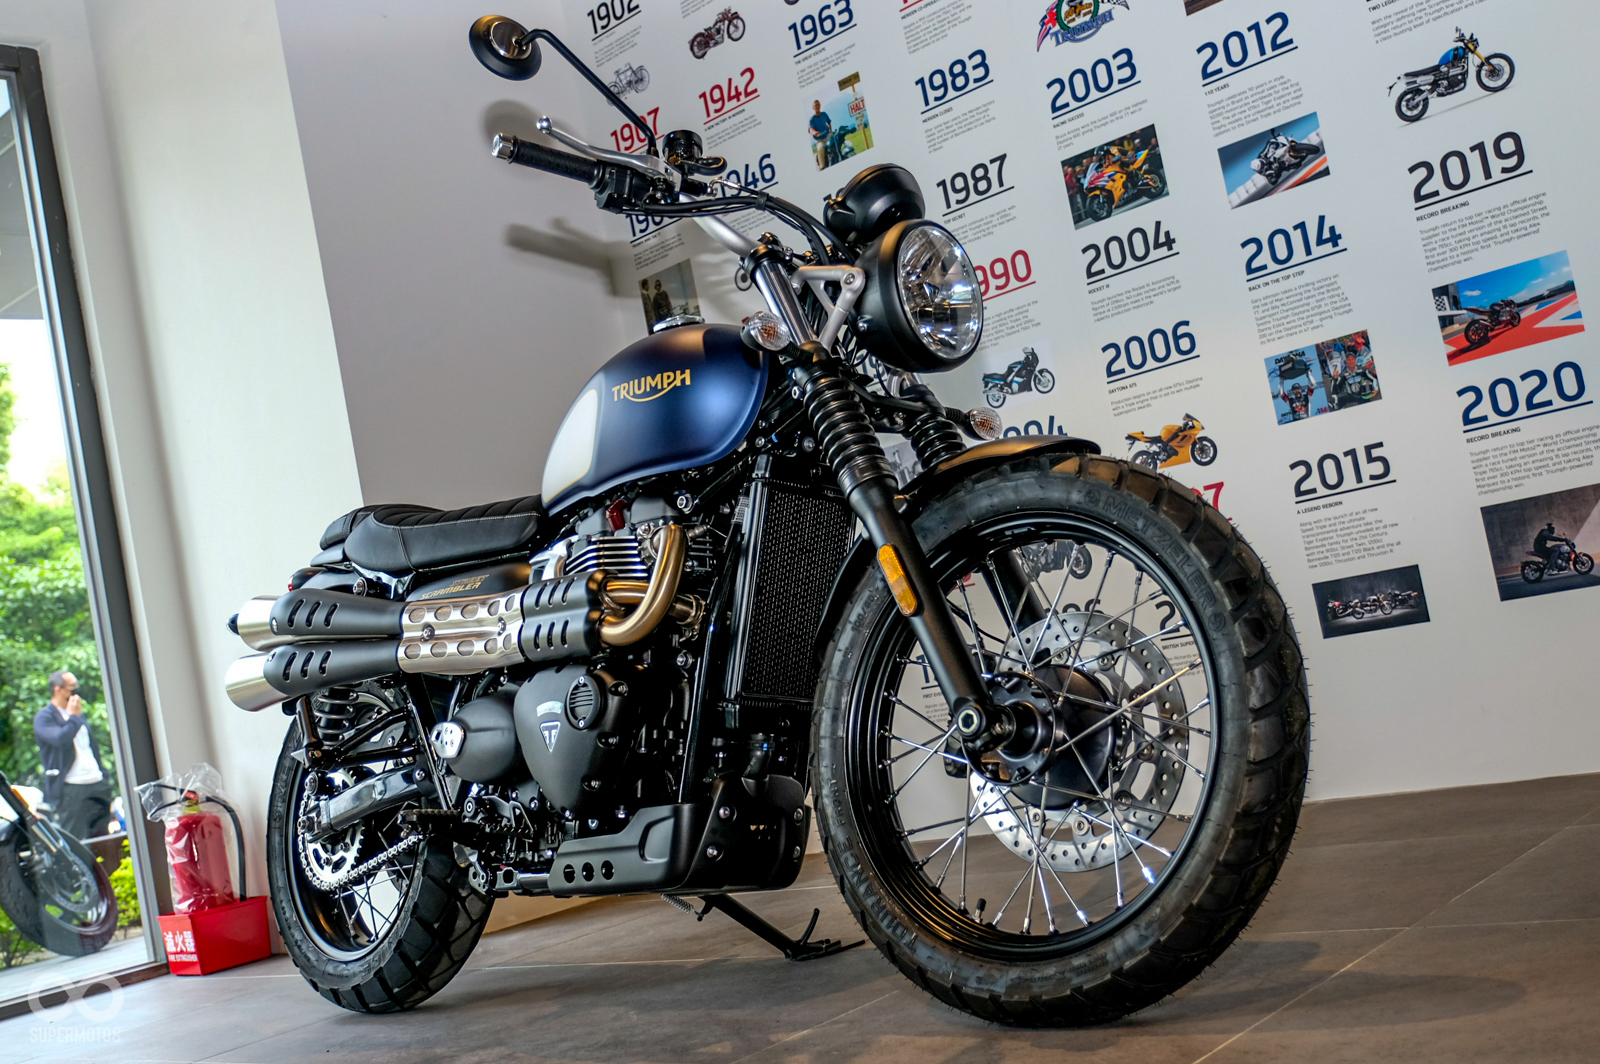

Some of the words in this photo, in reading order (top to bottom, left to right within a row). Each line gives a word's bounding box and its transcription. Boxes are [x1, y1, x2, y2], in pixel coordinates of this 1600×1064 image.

[587, 0, 640, 35] 1902
[788, 0, 853, 51] 1963
[1368, 5, 1381, 13] TWO
[1371, 17, 1383, 26] With
[1384, 13, 1393, 21] the
[1393, 7, 1408, 18] reveal
[1415, 1, 1424, 9] the
[1372, 12, 1416, 32] category-defining
[1374, 29, 1390, 38] names
[1391, 22, 1407, 31] return
[1414, 14, 1424, 22] the
[1424, 7, 1444, 20] Triumph
[1380, 26, 1412, 43] class-busting
[1413, 21, 1425, 30] level
[1431, 6, 1463, 22] specification
[1464, 2, 1475, 10] and
[1050, 9, 1114, 47] TRIUMPH
[1196, 12, 1294, 80] 2012
[698, 67, 758, 118] 1942
[914, 49, 990, 107] 1983
[1046, 48, 1137, 114] 2003
[849, 99, 866, 115] HALT
[936, 153, 1007, 209] 1987
[1407, 131, 1526, 204] 2019
[1416, 210, 1439, 222] RECORD
[1440, 200, 1470, 214] BREAKING
[1490, 211, 1506, 220] World
[1081, 220, 1176, 280] 2004
[1240, 214, 1342, 276] 2014
[974, 249, 1032, 297] 990
[1248, 284, 1261, 292] BACK
[1292, 270, 1305, 278] STEP
[1101, 320, 1196, 378] 2006
[612, 369, 691, 403] TRIUMPH
[1108, 385, 1128, 394] DAYTONA
[1456, 361, 1586, 427] 2020
[1466, 434, 1490, 444] RECORD
[1490, 426, 1521, 438] BREAKING
[1469, 449, 1490, 457] Triumph
[1491, 445, 1508, 453] return
[1562, 428, 1581, 436] official
[1581, 423, 1600, 432] engine
[1471, 456, 1491, 464] supplier
[1542, 440, 1558, 448] World
[1559, 432, 1598, 444] Championship
[1501, 456, 1518, 464] tuned
[1518, 452, 1538, 460] version
[1556, 442, 1583, 452] acclaimed
[1584, 438, 1600, 446] Street
[1288, 441, 1391, 498] 2015
[1301, 505, 1321, 514] LEGEND
[1322, 501, 1343, 509] REBORN
[1478, 485, 1514, 496] championship
[420, 581, 482, 600] SCRAMBLER
[1162, 642, 1180, 650] BRITISH
